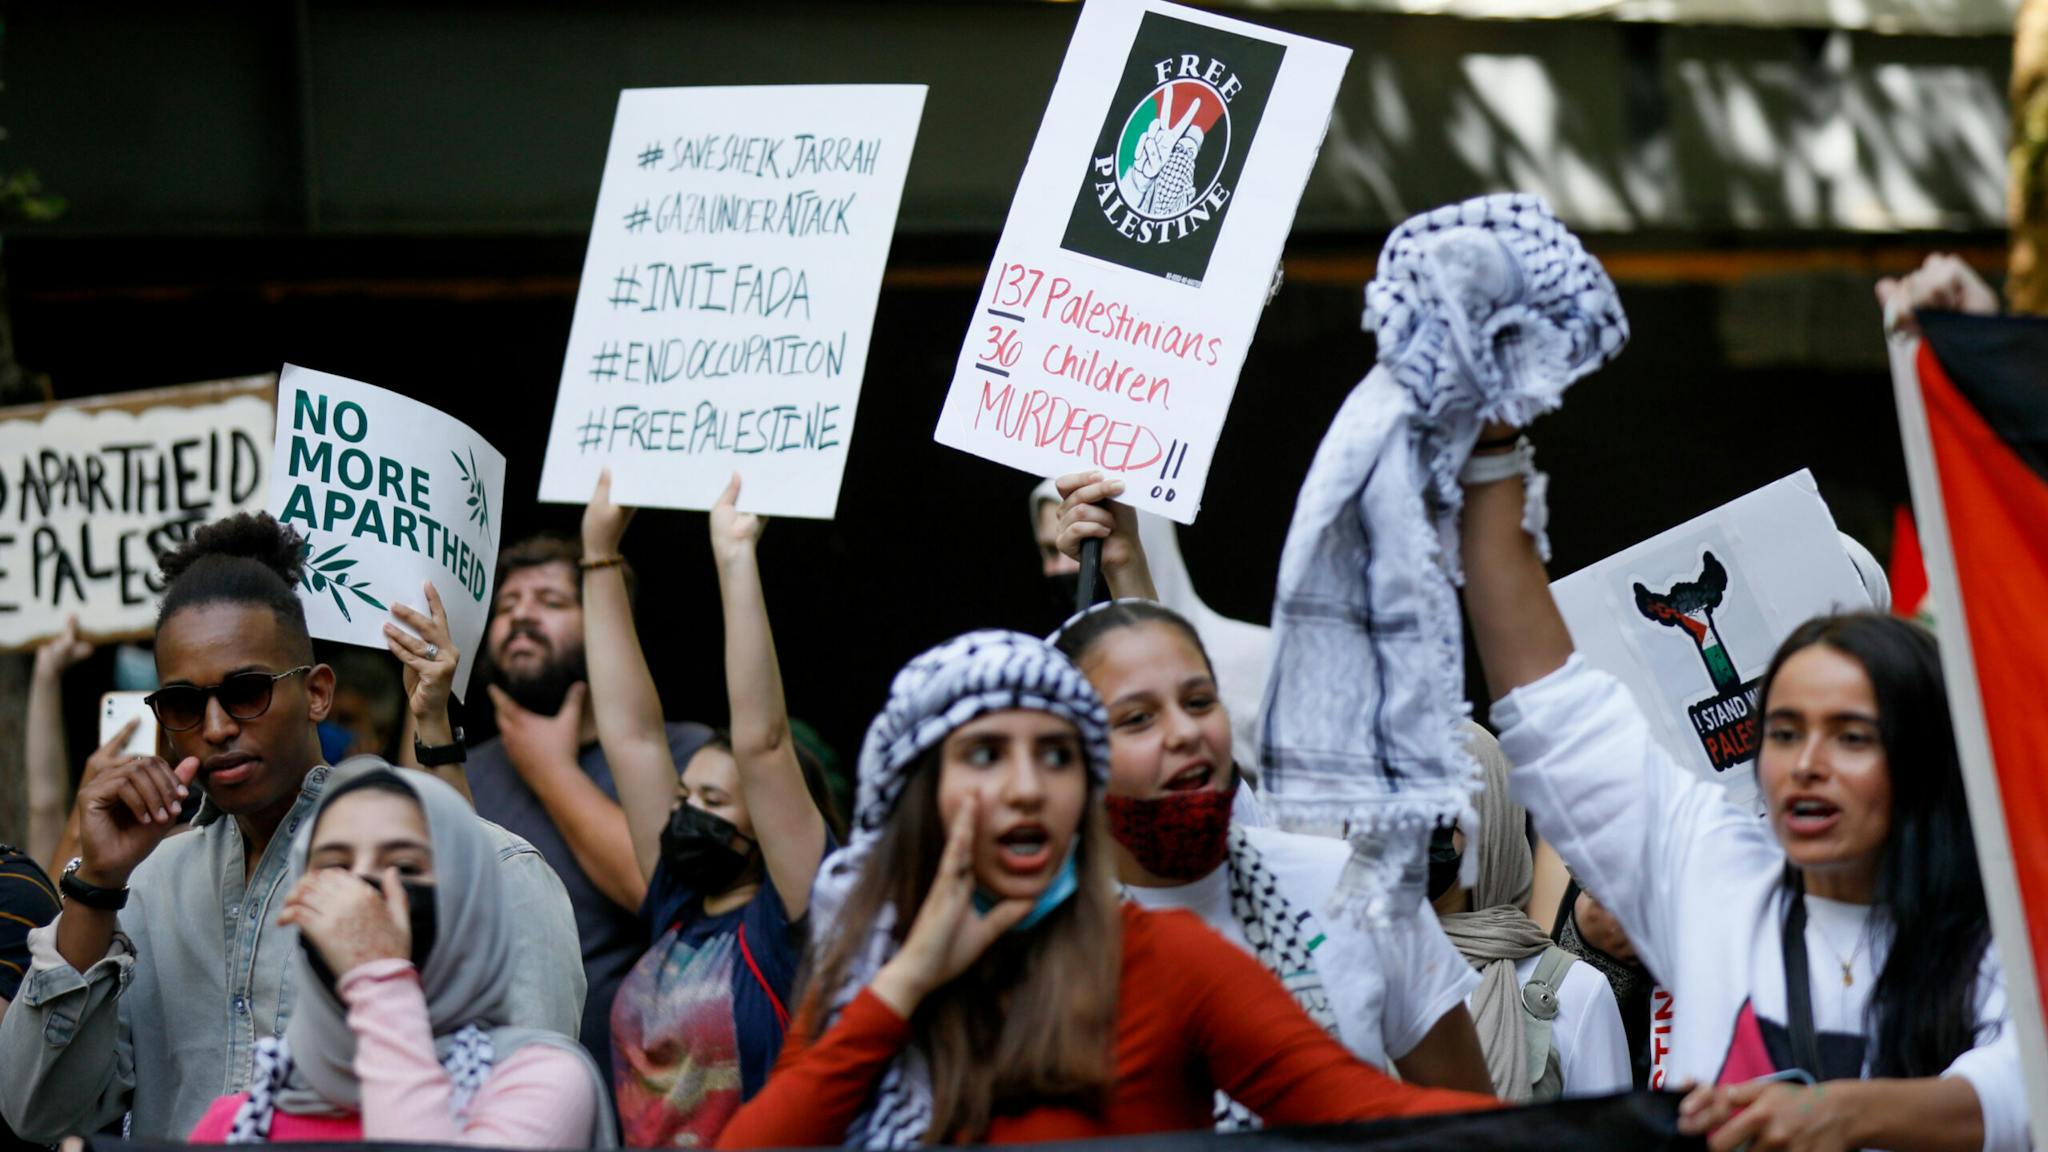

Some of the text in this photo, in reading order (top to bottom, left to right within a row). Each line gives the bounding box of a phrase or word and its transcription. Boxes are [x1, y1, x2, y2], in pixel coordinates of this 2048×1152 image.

[1155, 54, 1242, 103] FREE
[787, 134, 881, 178] JARRAH
[1095, 153, 1230, 243] PALESTINE
[992, 263, 1222, 366] 137 Palestinians
[979, 325, 1023, 367] 36
[293, 389, 368, 443] NO
[577, 400, 841, 454] #FREEPALESTINE
[20, 425, 260, 522] APARTHEID
[288, 436, 430, 512] MORE
[279, 484, 486, 603] APARTHEID
[1701, 696, 1748, 730] STAND
